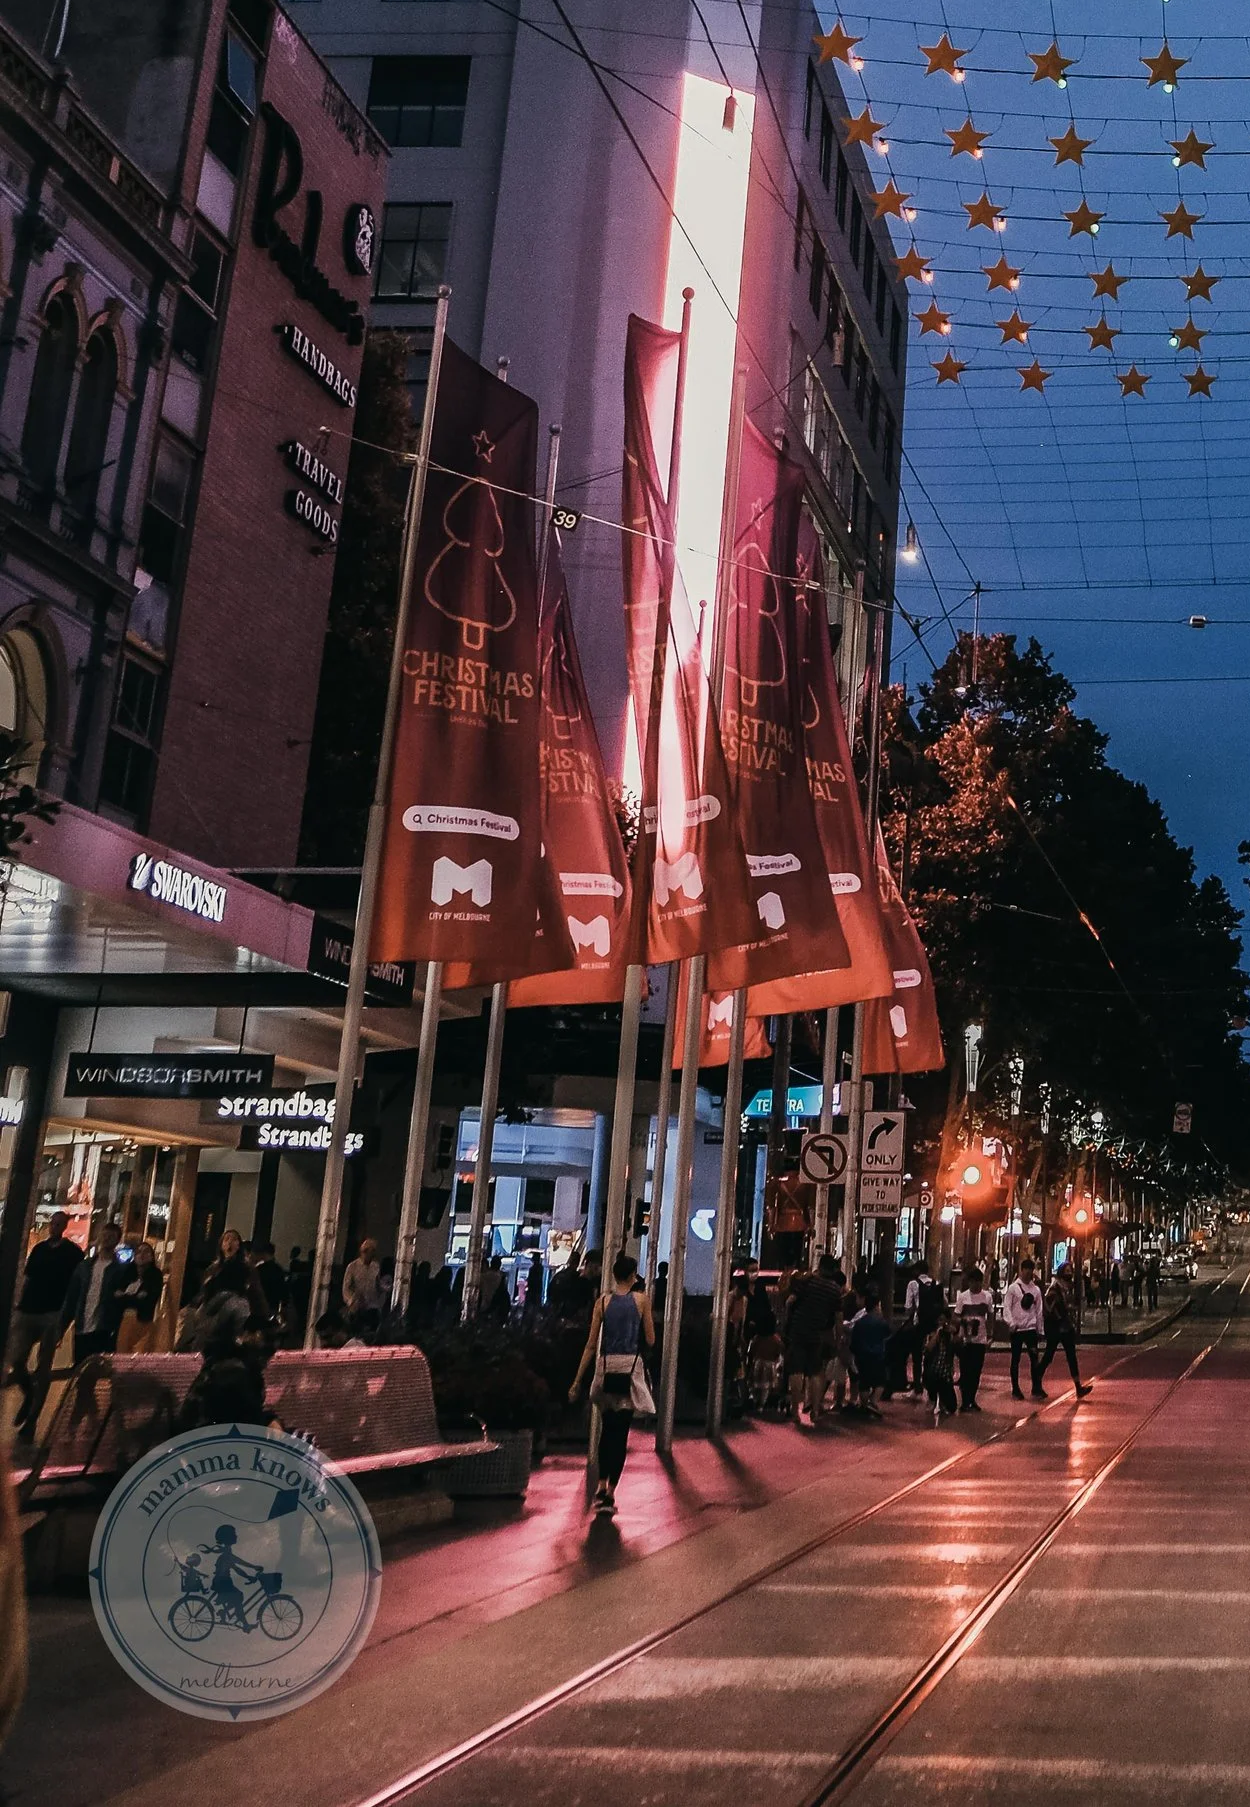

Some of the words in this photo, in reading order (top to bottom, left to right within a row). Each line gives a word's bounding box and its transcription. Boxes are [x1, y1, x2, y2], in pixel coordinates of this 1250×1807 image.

[293, 327, 357, 408] HANDBAGS
[295, 442, 342, 504] TRAVEL
[295, 490, 338, 542] GOODS
[553, 510, 577, 529] 39
[403, 650, 534, 698] CHRISTMAS
[413, 680, 519, 724] FESTIVAL
[427, 813, 478, 827] Christmas
[481, 818, 512, 833] Festival
[759, 859, 793, 870] Festival
[151, 860, 227, 923] SWAROVSKI
[429, 911, 442, 921] CITY
[444, 911, 452, 920] OF
[453, 912, 491, 922] MELBOURNE
[866, 1154, 897, 1166] ONLY
[863, 1177, 879, 1187] GIVE
[883, 1177, 900, 1187] WAY
[876, 1190, 885, 1199] TO
[862, 1203, 898, 1213] PEDESTRIANS
